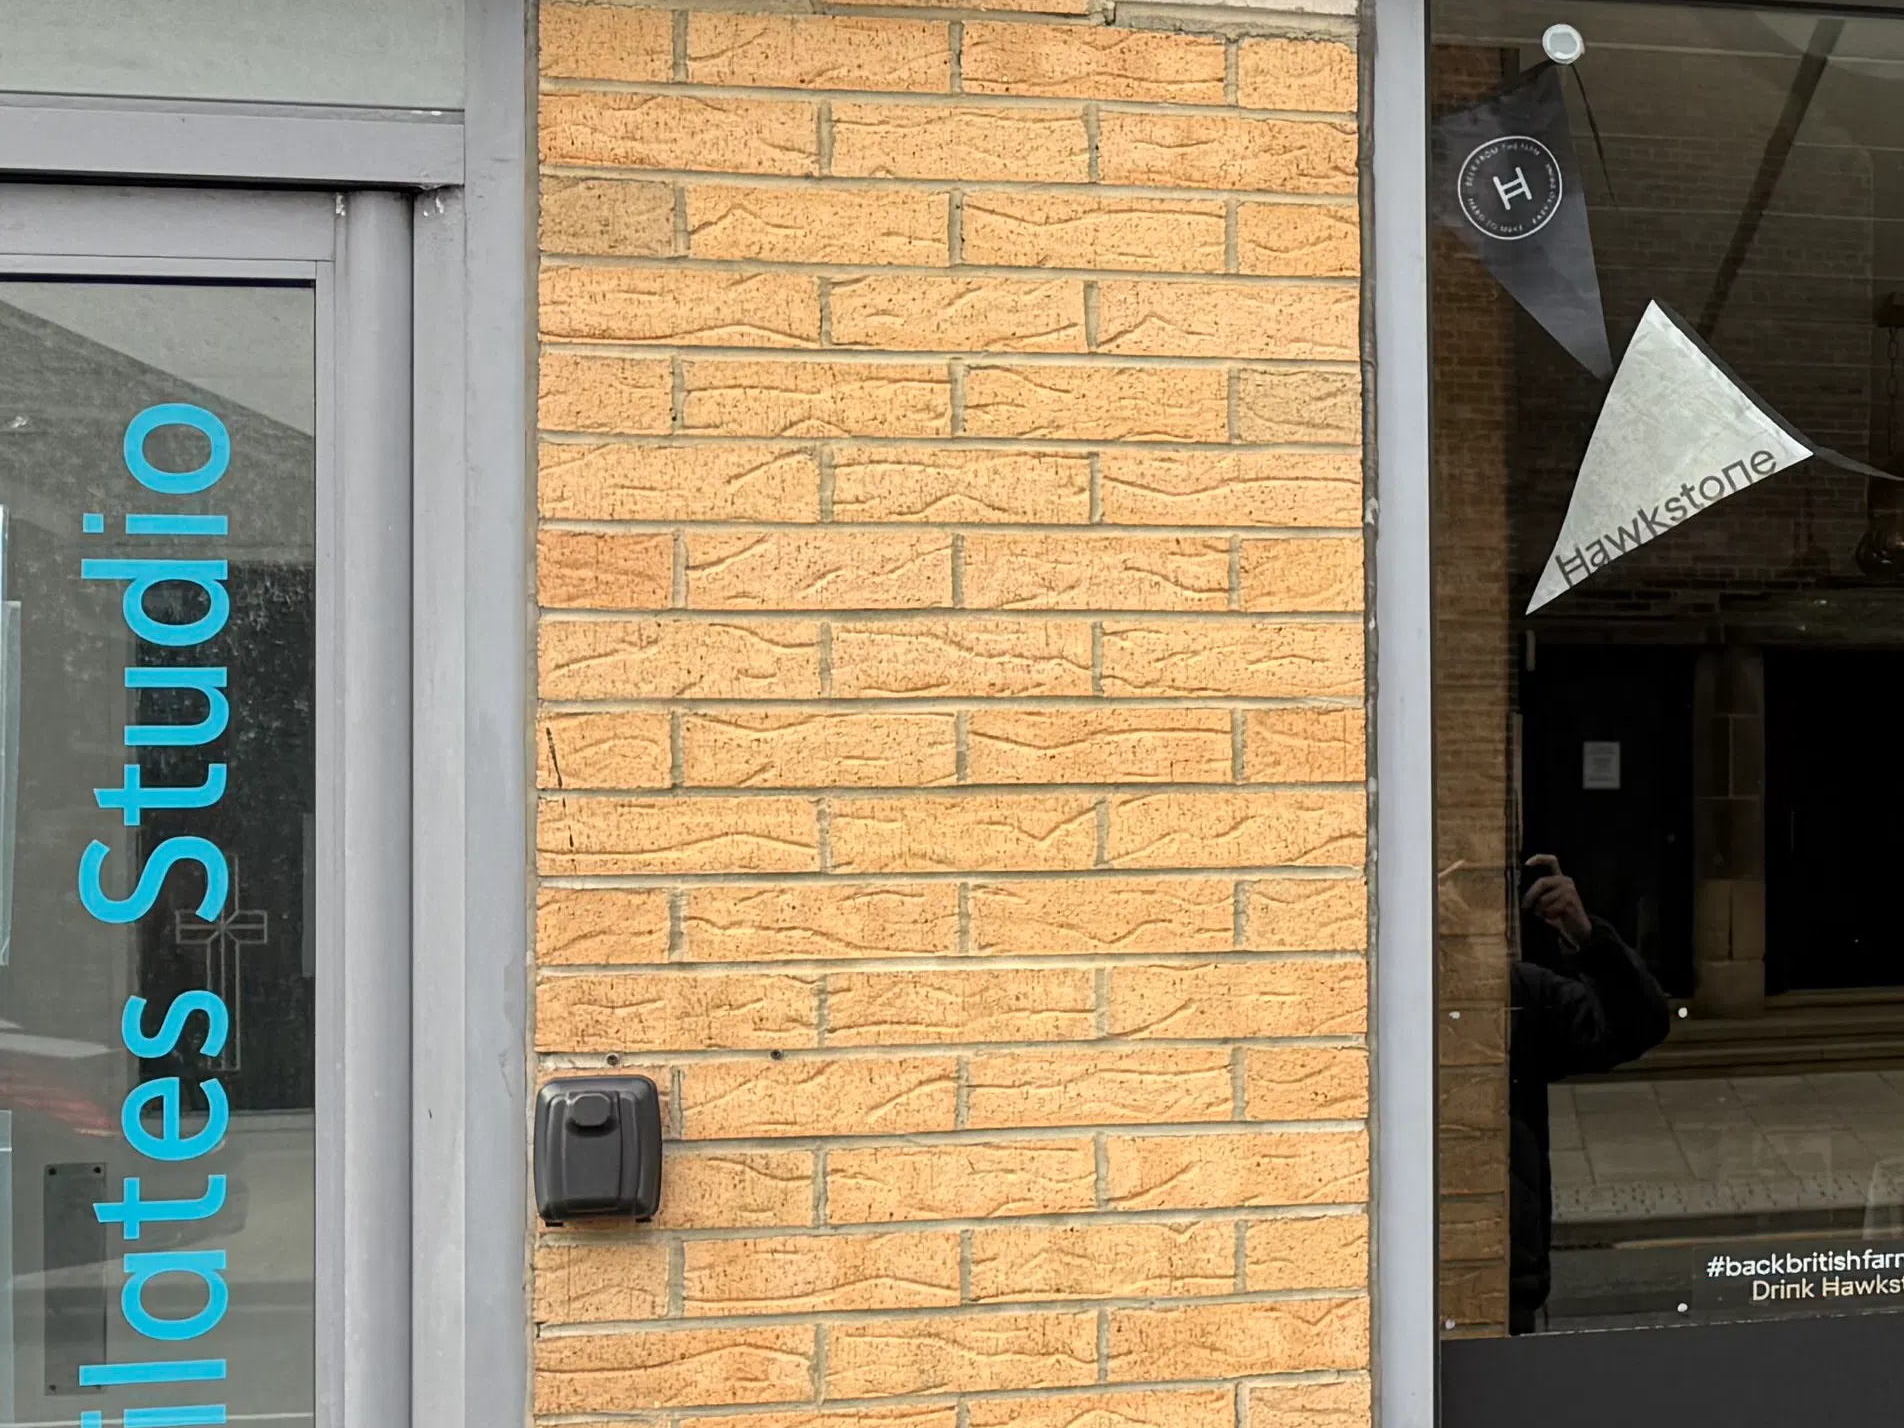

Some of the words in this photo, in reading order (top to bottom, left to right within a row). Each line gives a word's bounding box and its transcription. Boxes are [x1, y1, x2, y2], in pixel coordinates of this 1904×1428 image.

[1555, 450, 1777, 588] Hawkstone
[79, 403, 231, 924] Studio
[1752, 1277, 1814, 1301] Drink
